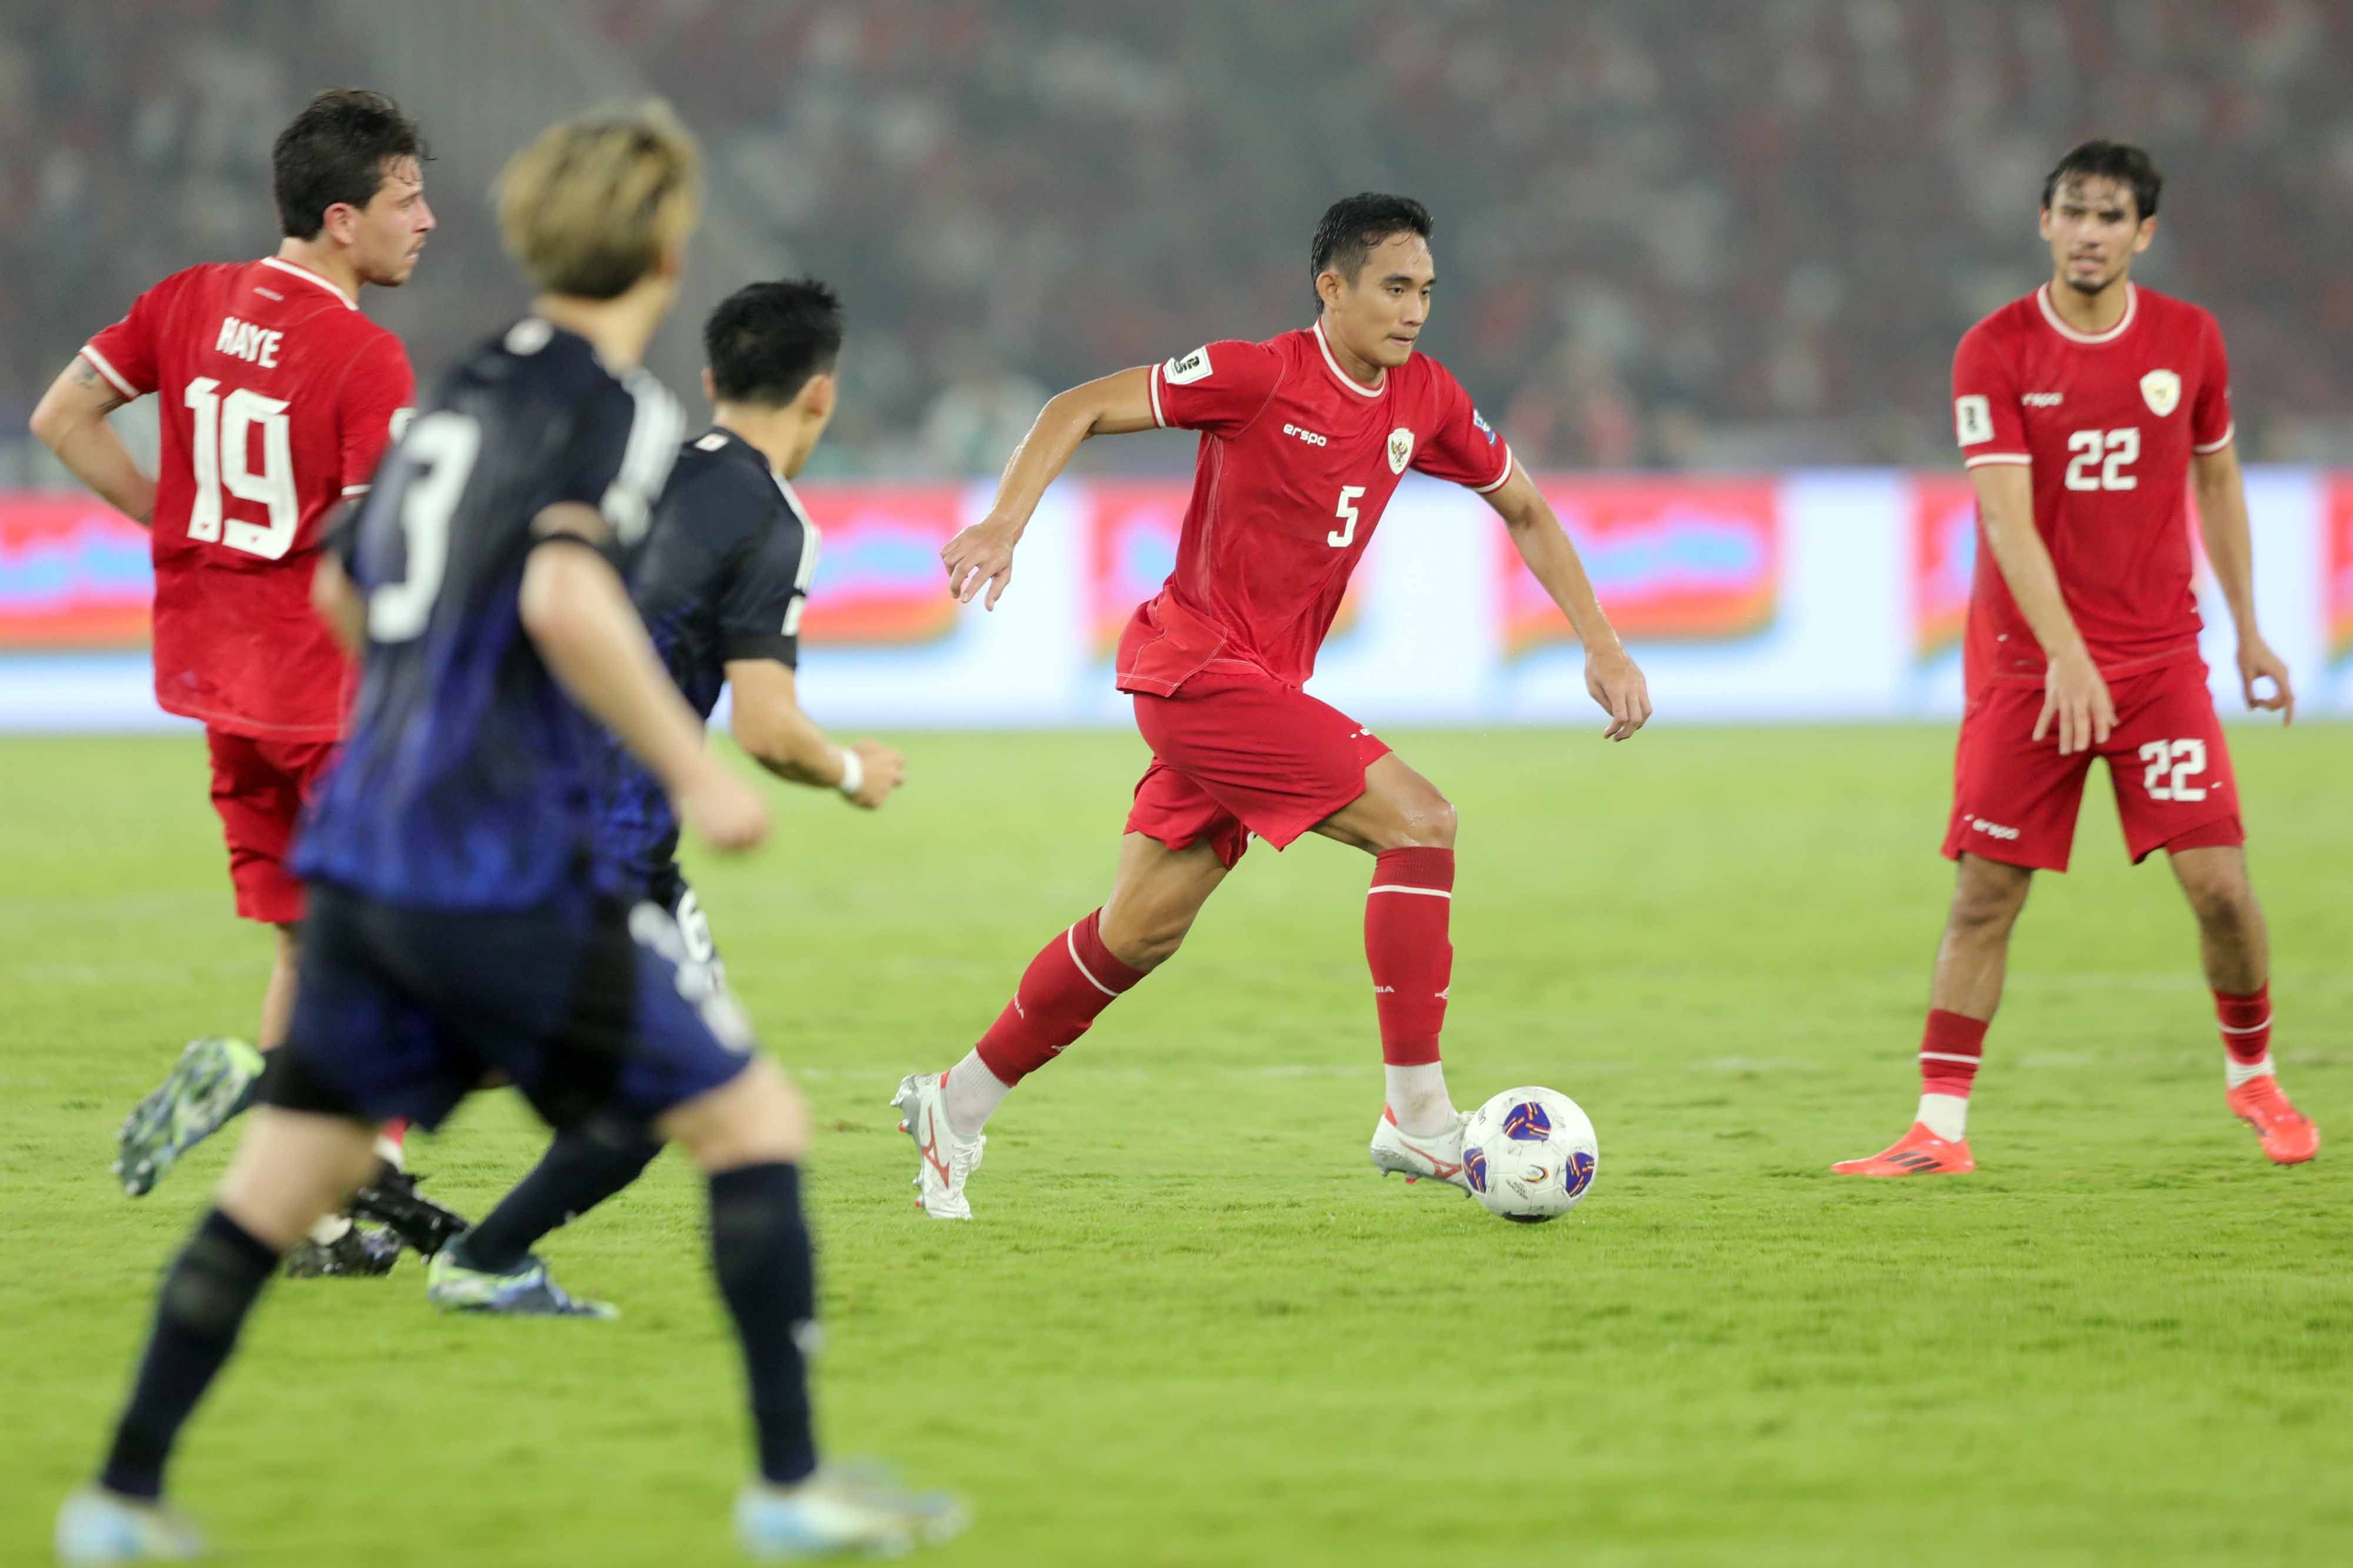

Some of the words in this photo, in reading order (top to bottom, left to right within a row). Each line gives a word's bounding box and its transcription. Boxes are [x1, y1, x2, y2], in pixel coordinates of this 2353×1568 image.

[214, 316, 284, 369] HAYE
[1283, 422, 1327, 447] erspo
[2064, 426, 2140, 491] 22
[184, 376, 299, 561] 19
[368, 409, 483, 644] 3
[1327, 485, 1366, 547] 5
[2139, 738, 2207, 801] 22
